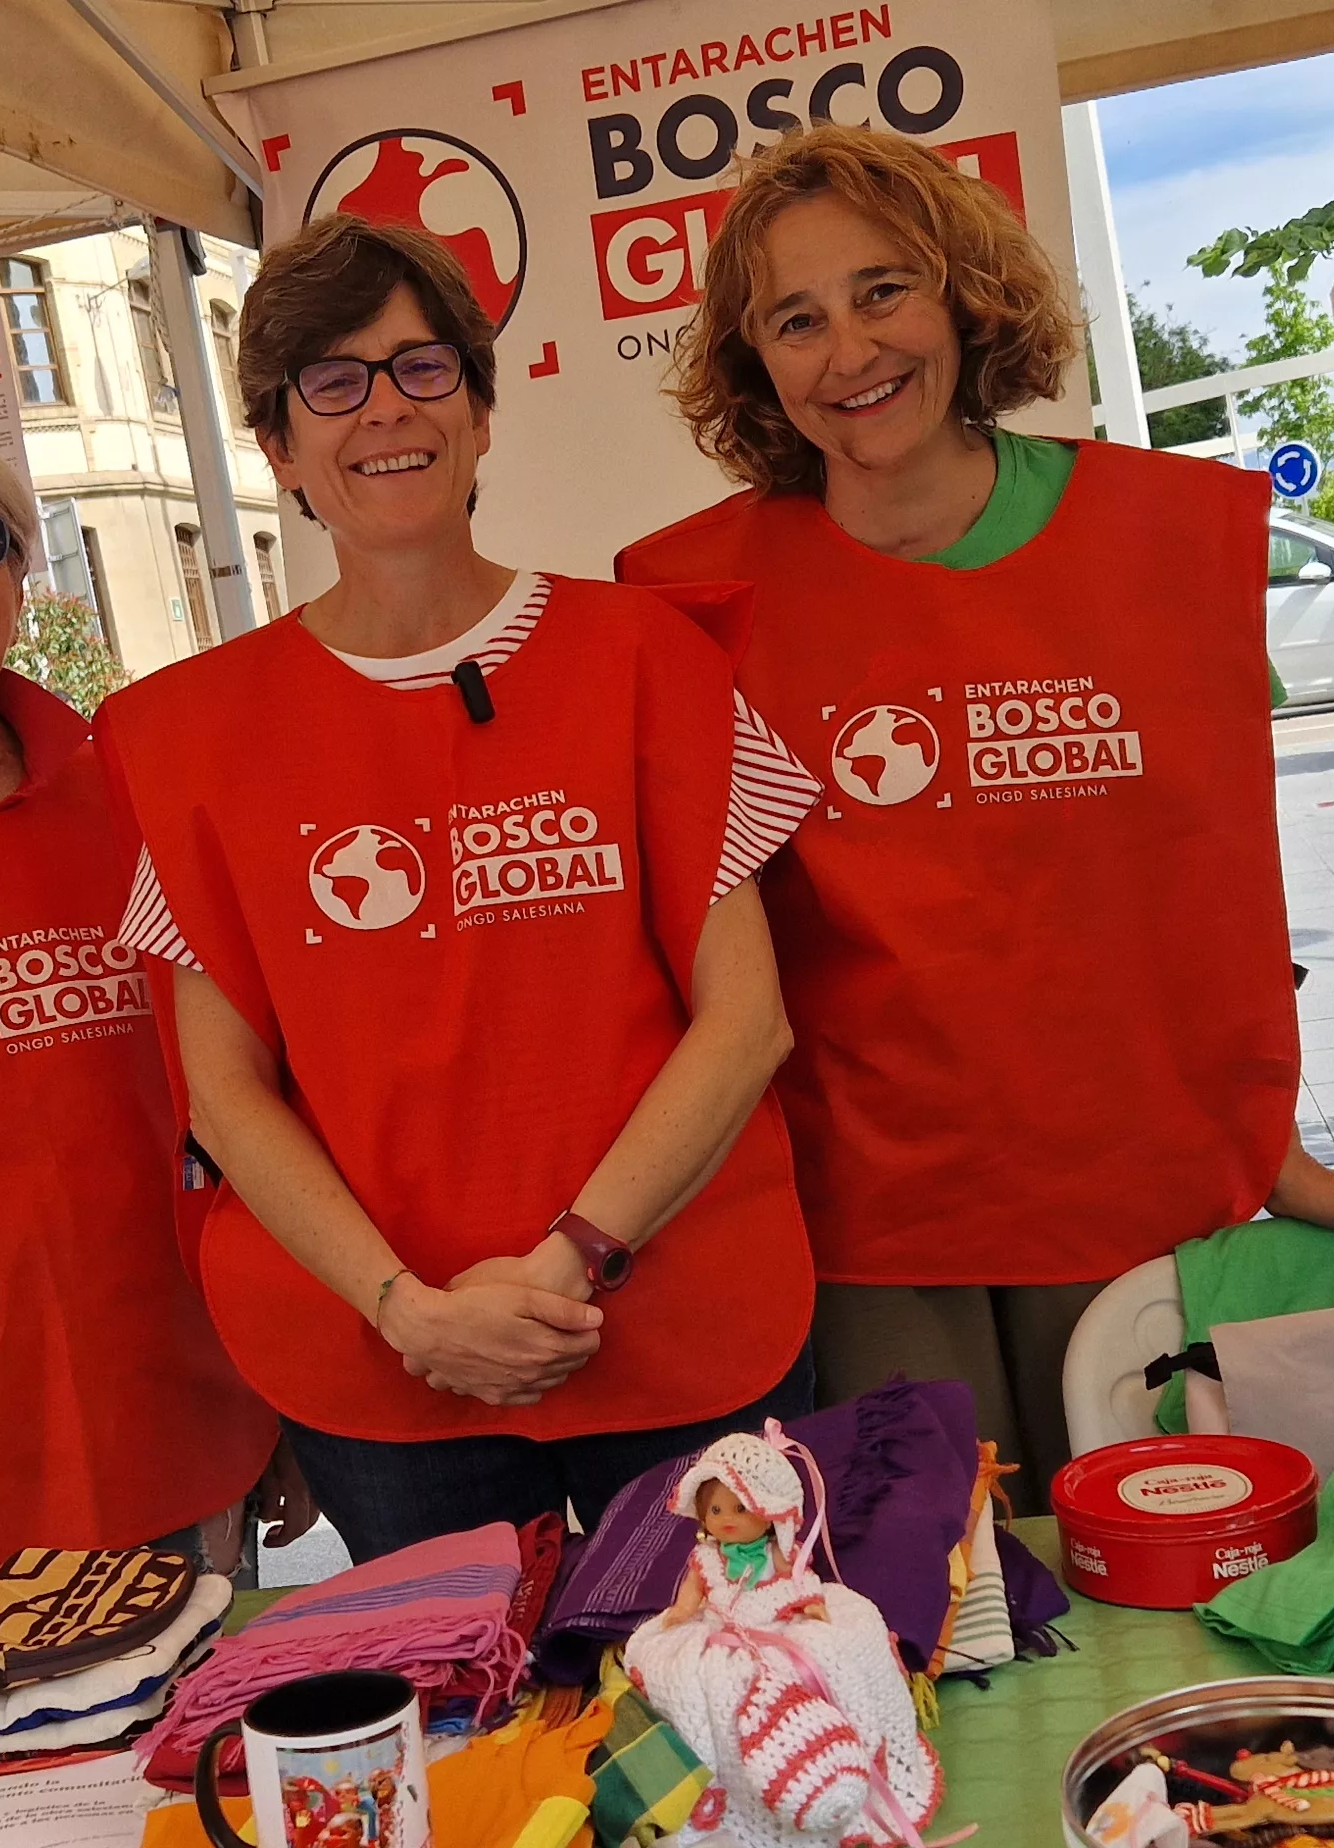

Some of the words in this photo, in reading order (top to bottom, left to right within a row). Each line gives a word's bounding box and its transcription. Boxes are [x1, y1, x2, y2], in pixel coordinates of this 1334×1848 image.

[581, 4, 892, 102] ENTARACHEN
[587, 45, 964, 199] BOSCO
[965, 676, 1094, 699] ENTARACHEN
[967, 693, 1121, 738] BOSCO
[973, 739, 1137, 781] GLOBAL
[448, 789, 566, 825] NTARACHEN
[976, 790, 1023, 804] ONGD
[1030, 785, 1108, 801] SALESIANA
[450, 807, 598, 866] BOSCO
[455, 853, 617, 906] GLOBAL
[457, 912, 495, 932] ONGD
[503, 901, 585, 922] SALESIANA
[0, 978, 150, 1030] GLOBAL
[6, 1036, 54, 1055] ONGD
[61, 1023, 134, 1044] SALESIANA
[1144, 1473, 1213, 1486] Caja-roja
[1215, 1541, 1263, 1560] Caja-roja
[45, 1778, 60, 1786] la
